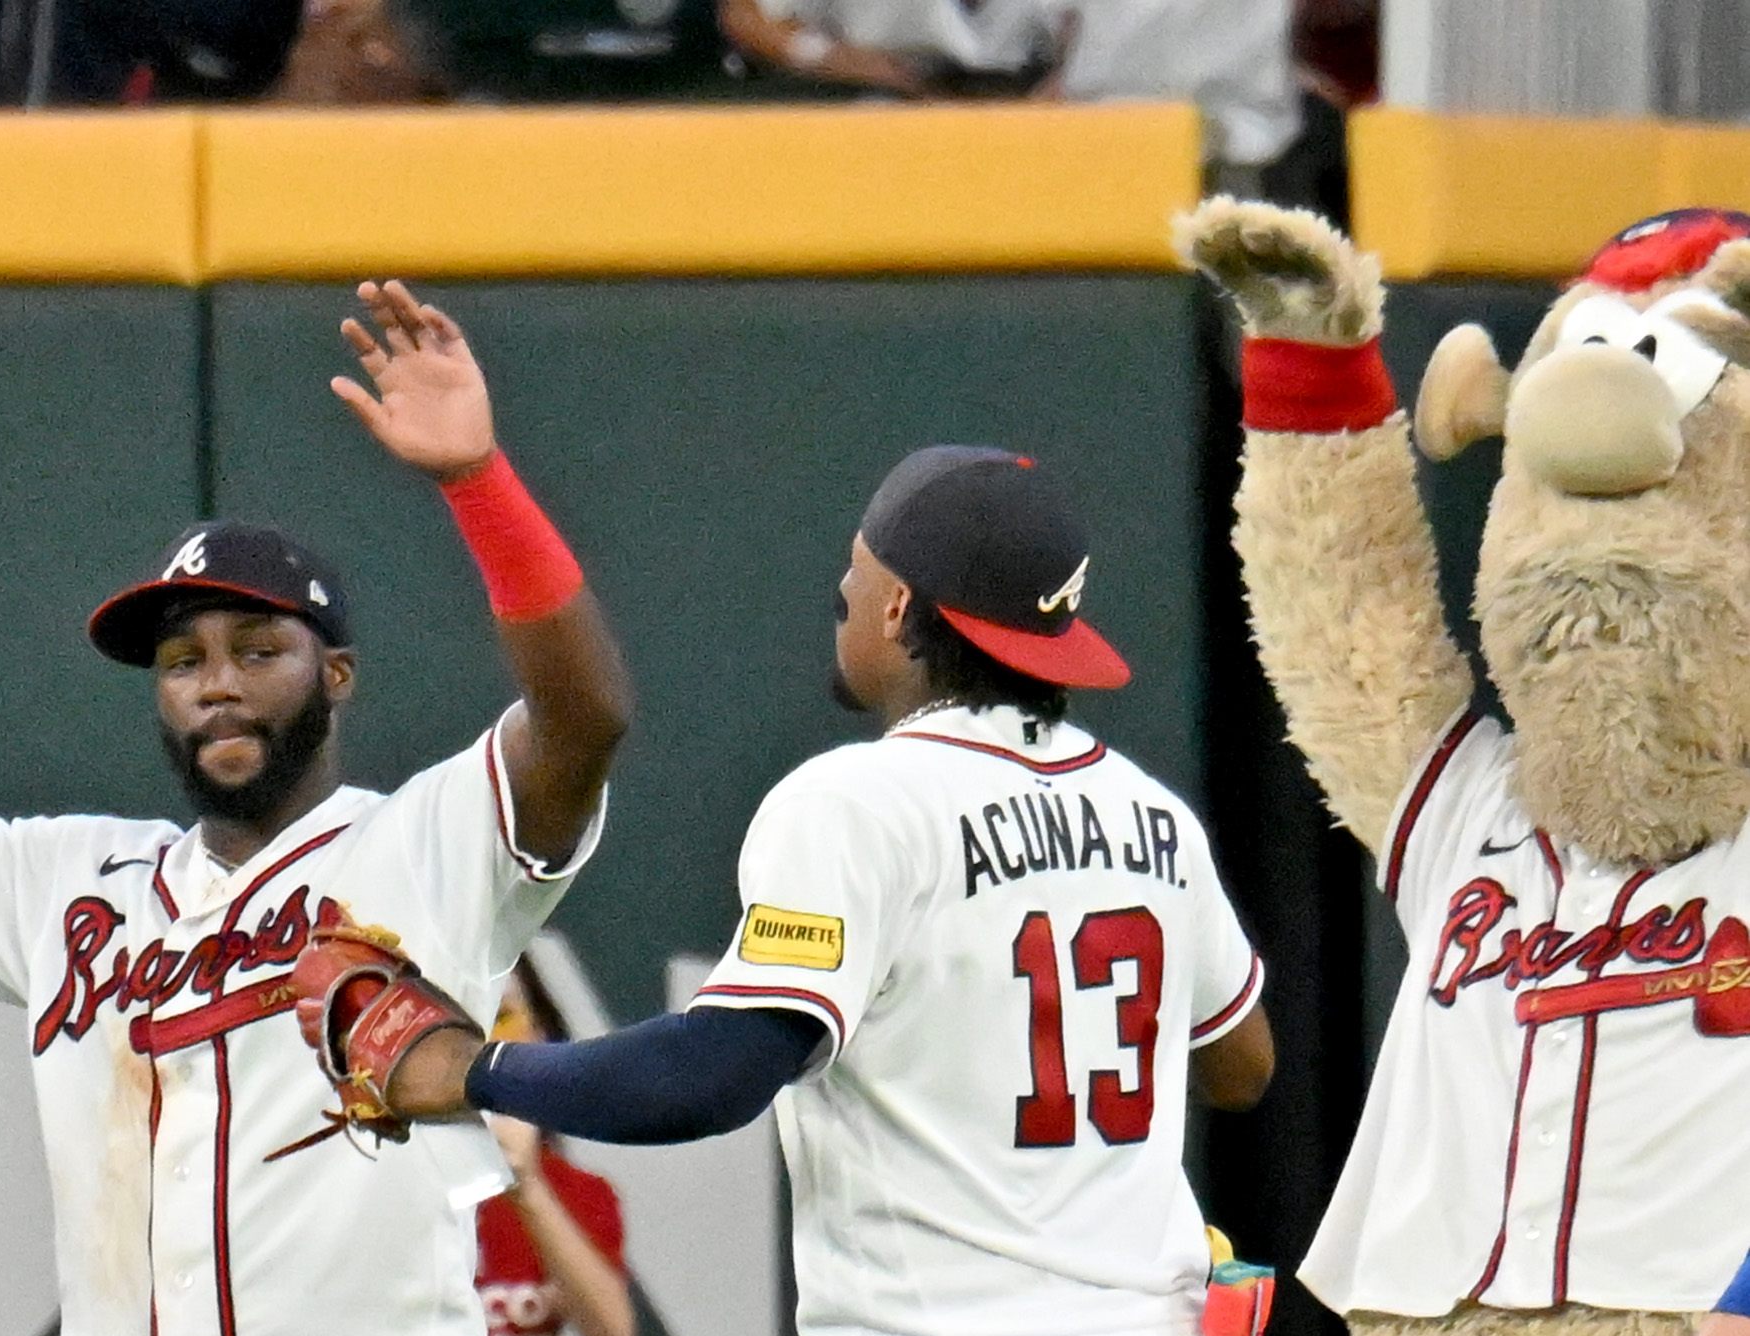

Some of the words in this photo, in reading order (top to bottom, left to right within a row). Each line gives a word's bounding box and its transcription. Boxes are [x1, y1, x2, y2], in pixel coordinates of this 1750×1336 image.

[959, 777, 1113, 899] ACUÑA
[1123, 800, 1188, 890] JR.
[33, 883, 310, 1058] Braves
[753, 918, 836, 948] QUIKRETE
[1428, 876, 1708, 1009] Braves
[1012, 905, 1164, 1148] 13
